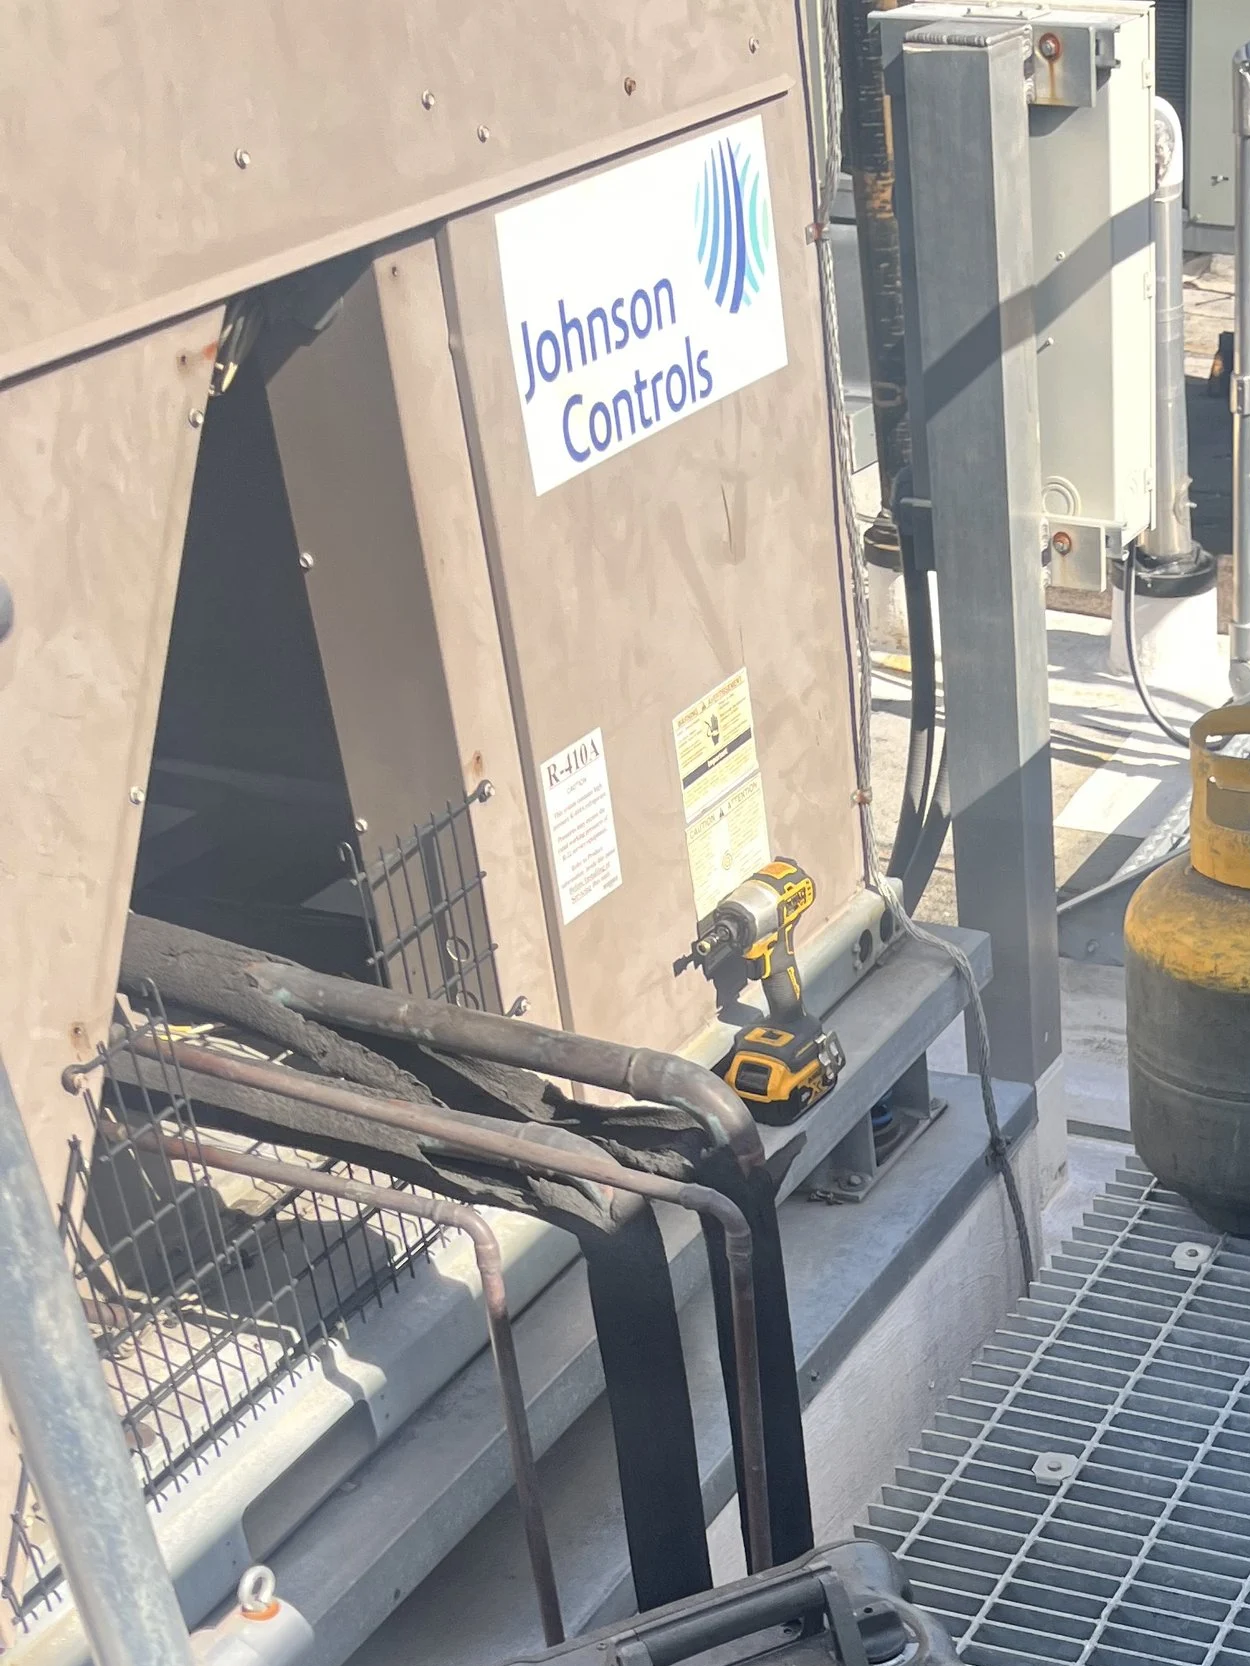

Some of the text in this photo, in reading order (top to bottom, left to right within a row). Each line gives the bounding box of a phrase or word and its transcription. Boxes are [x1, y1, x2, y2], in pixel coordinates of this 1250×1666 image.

[521, 278, 676, 404] Johnson
[562, 336, 713, 463] Controls
[547, 738, 600, 787] R-410A
